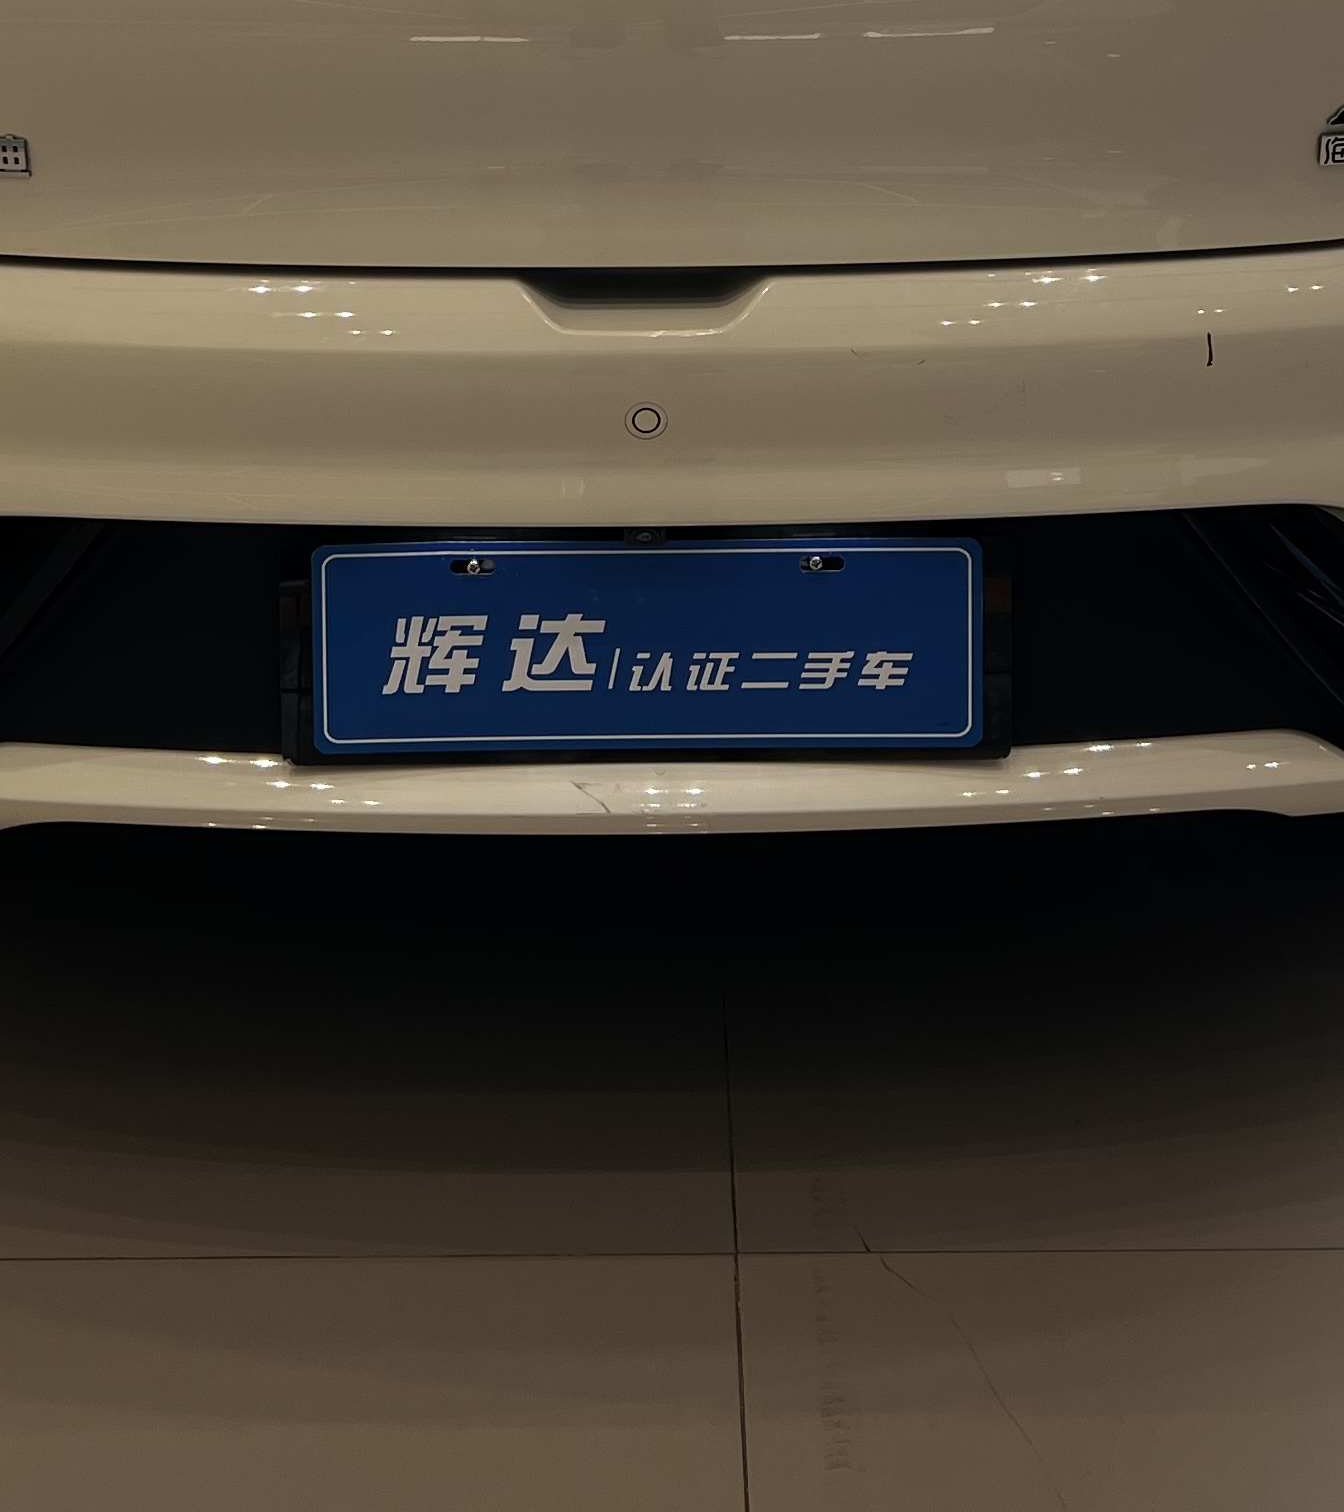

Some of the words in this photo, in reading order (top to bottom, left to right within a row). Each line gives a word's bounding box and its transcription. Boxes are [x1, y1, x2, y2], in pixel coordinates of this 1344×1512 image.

[382, 613, 606, 695] 辉达
[629, 649, 914, 692] 认证二手车
